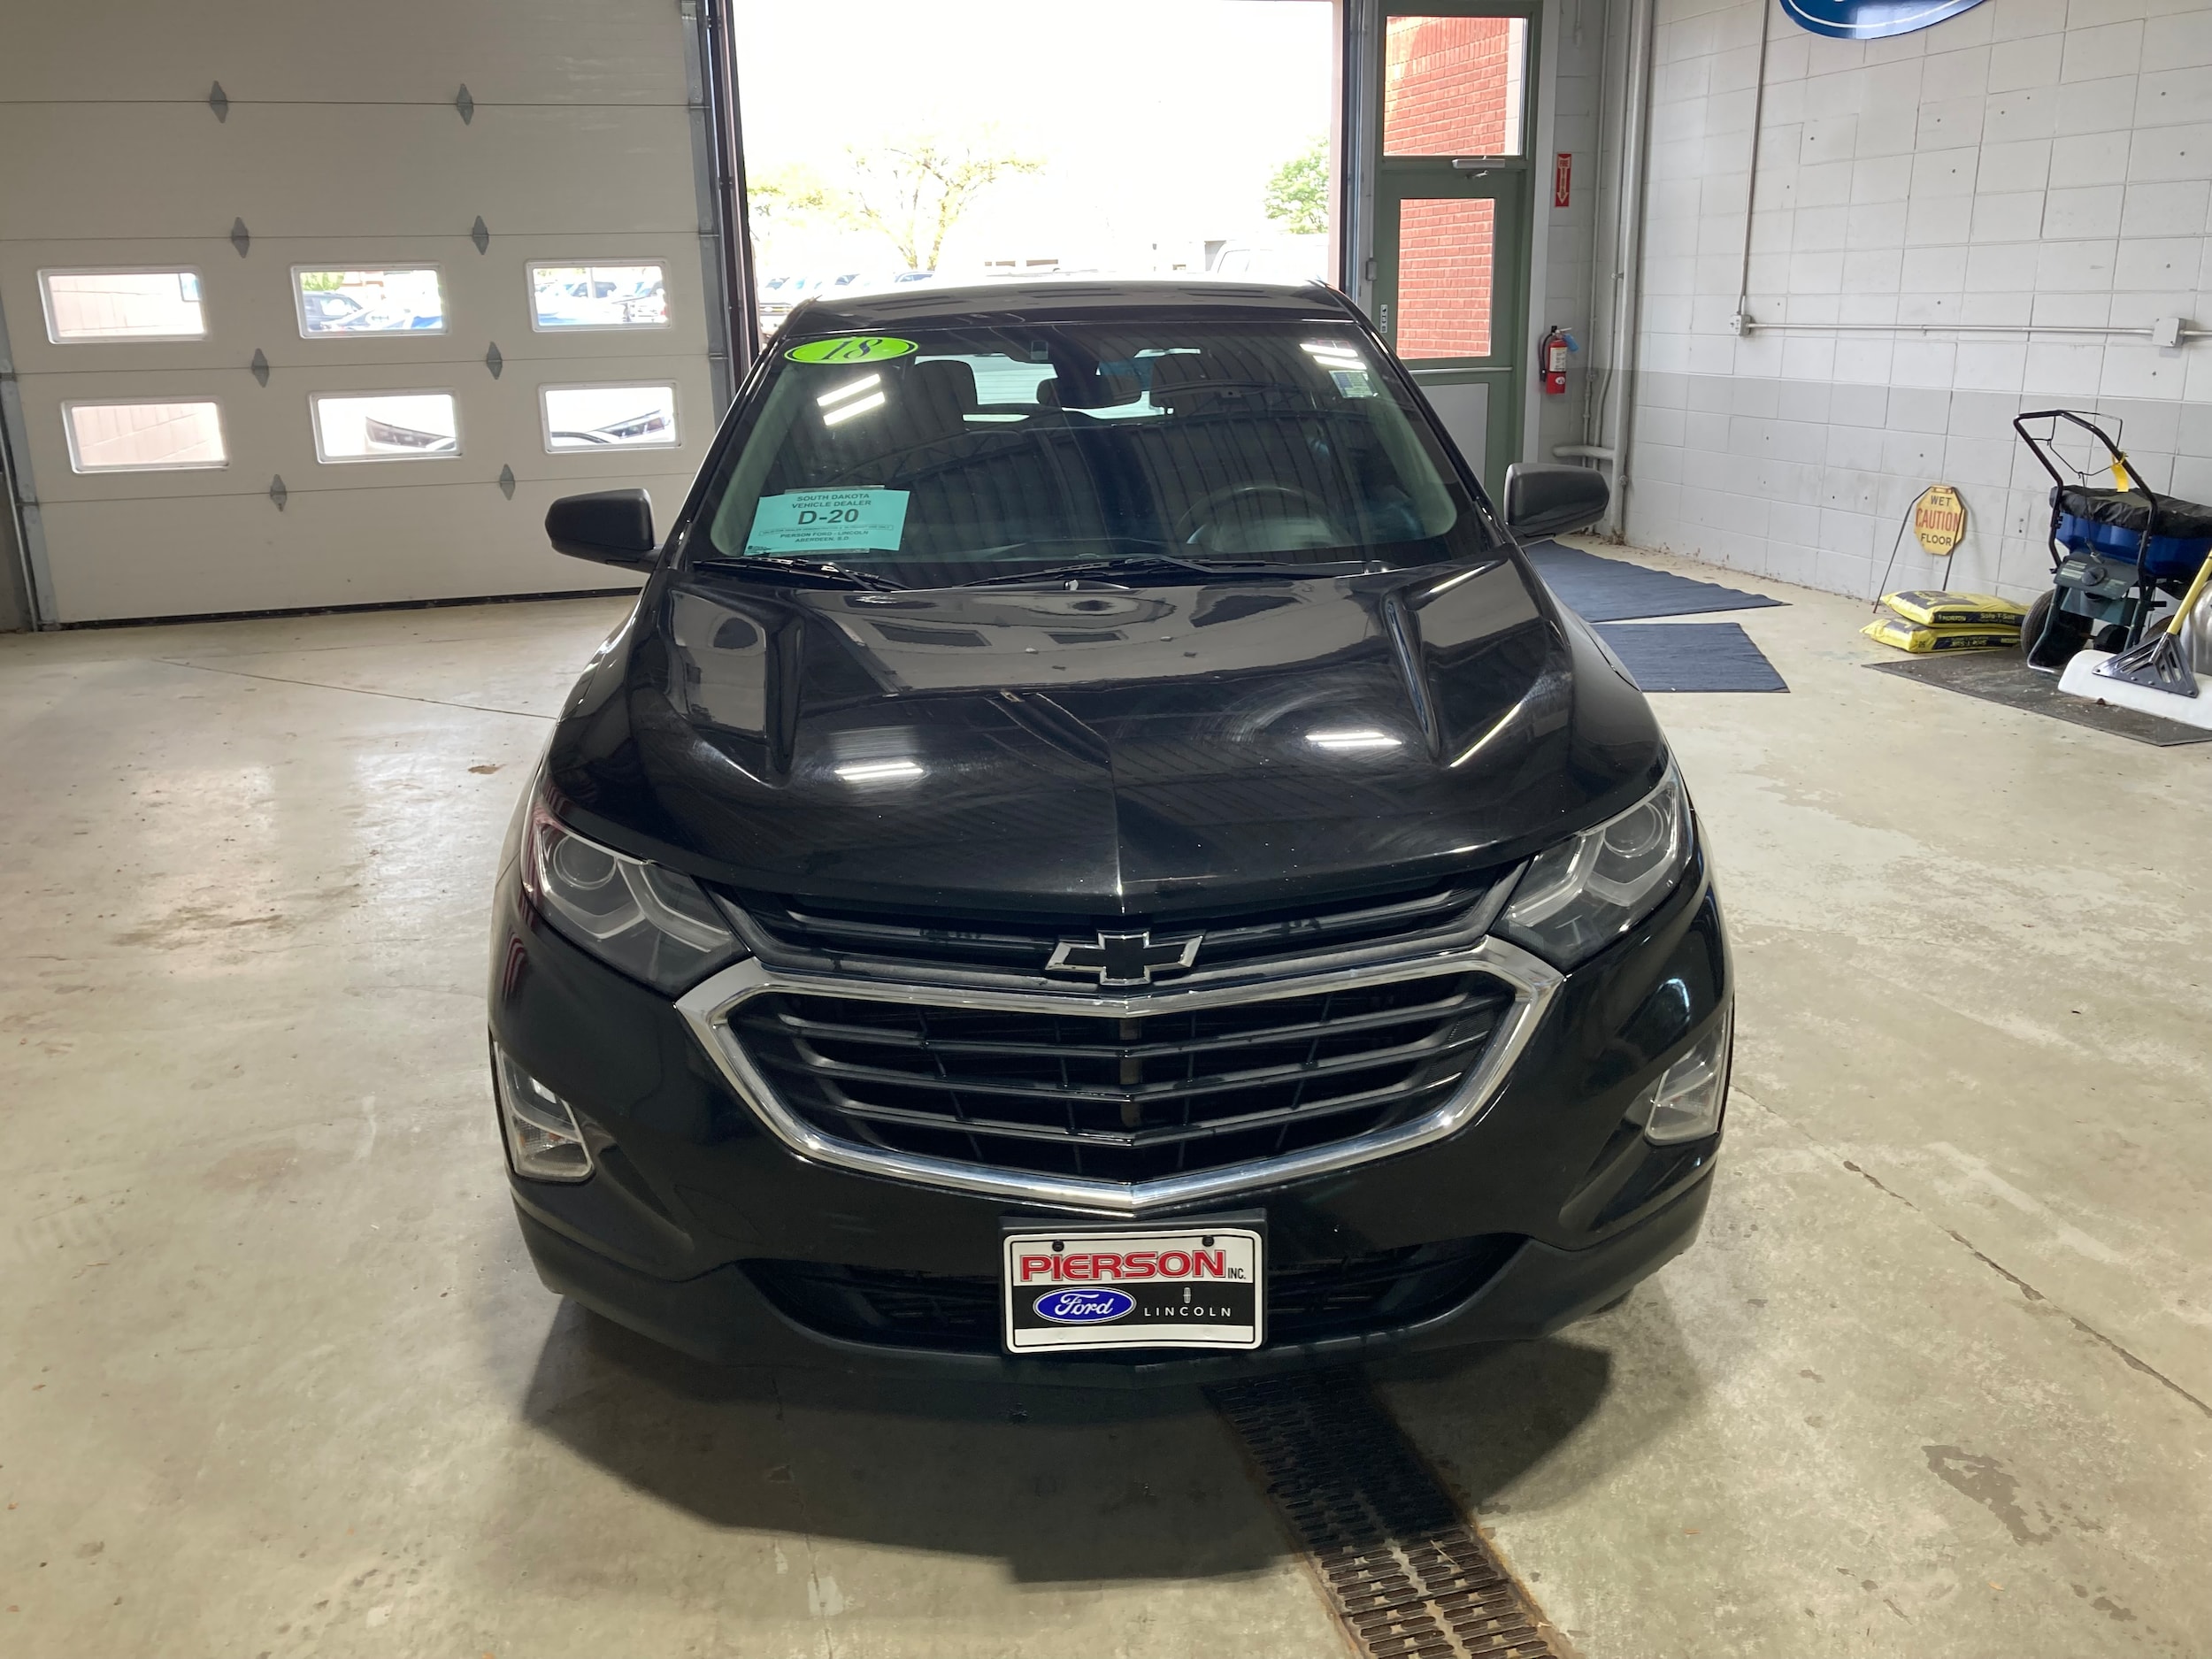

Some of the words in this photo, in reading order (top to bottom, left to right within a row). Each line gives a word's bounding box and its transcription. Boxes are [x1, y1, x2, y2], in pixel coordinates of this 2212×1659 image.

[819, 339, 883, 361] 18
[1931, 495, 1952, 507] WET
[798, 509, 859, 525] D-20
[1916, 507, 1960, 532] CAUTION
[1920, 533, 1952, 547] FLOOR
[1020, 1250, 1226, 1282] PIERSON
[1227, 1267, 1247, 1280] INC.
[1054, 1292, 1115, 1317] Ford
[1144, 1306, 1232, 1317] LINCOLN
